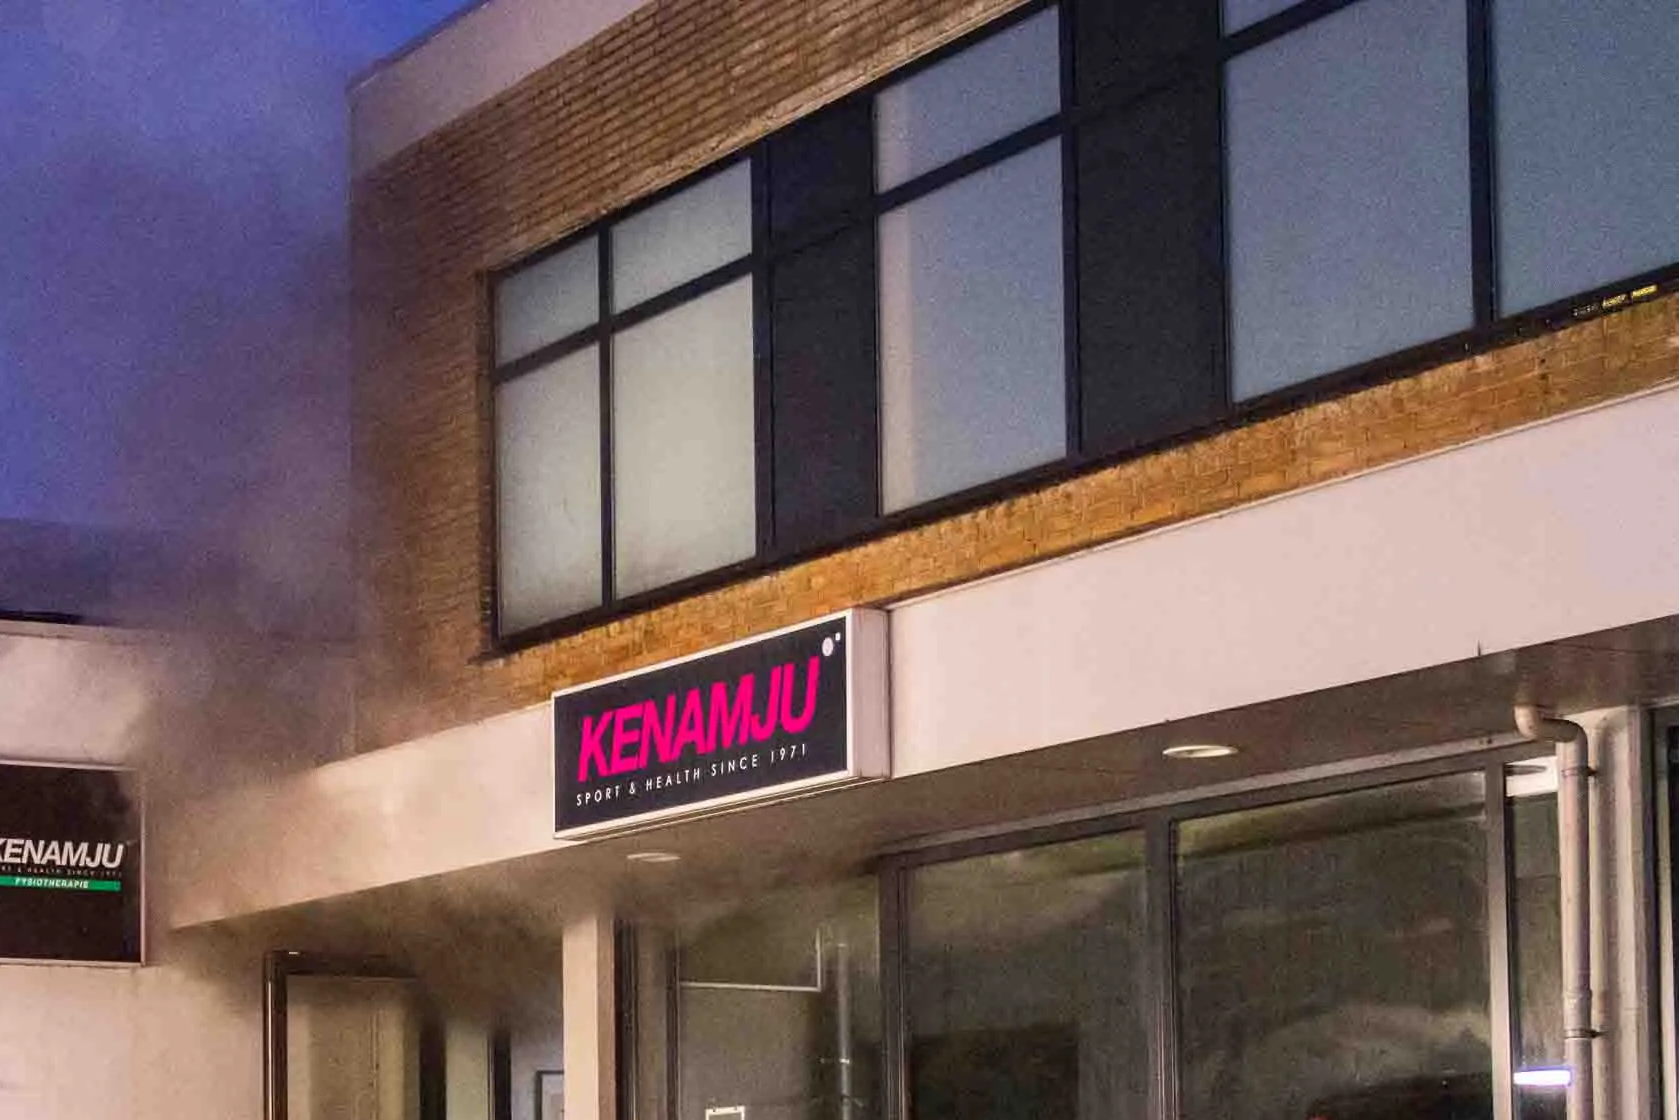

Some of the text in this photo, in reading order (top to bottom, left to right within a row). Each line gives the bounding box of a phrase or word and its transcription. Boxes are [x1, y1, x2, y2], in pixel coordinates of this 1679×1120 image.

[577, 655, 820, 783] KENAMJU
[576, 743, 807, 807] SPORT & HEALTH SINCE 1971
[14, 877, 90, 889] FYSIOTHERAPIE
